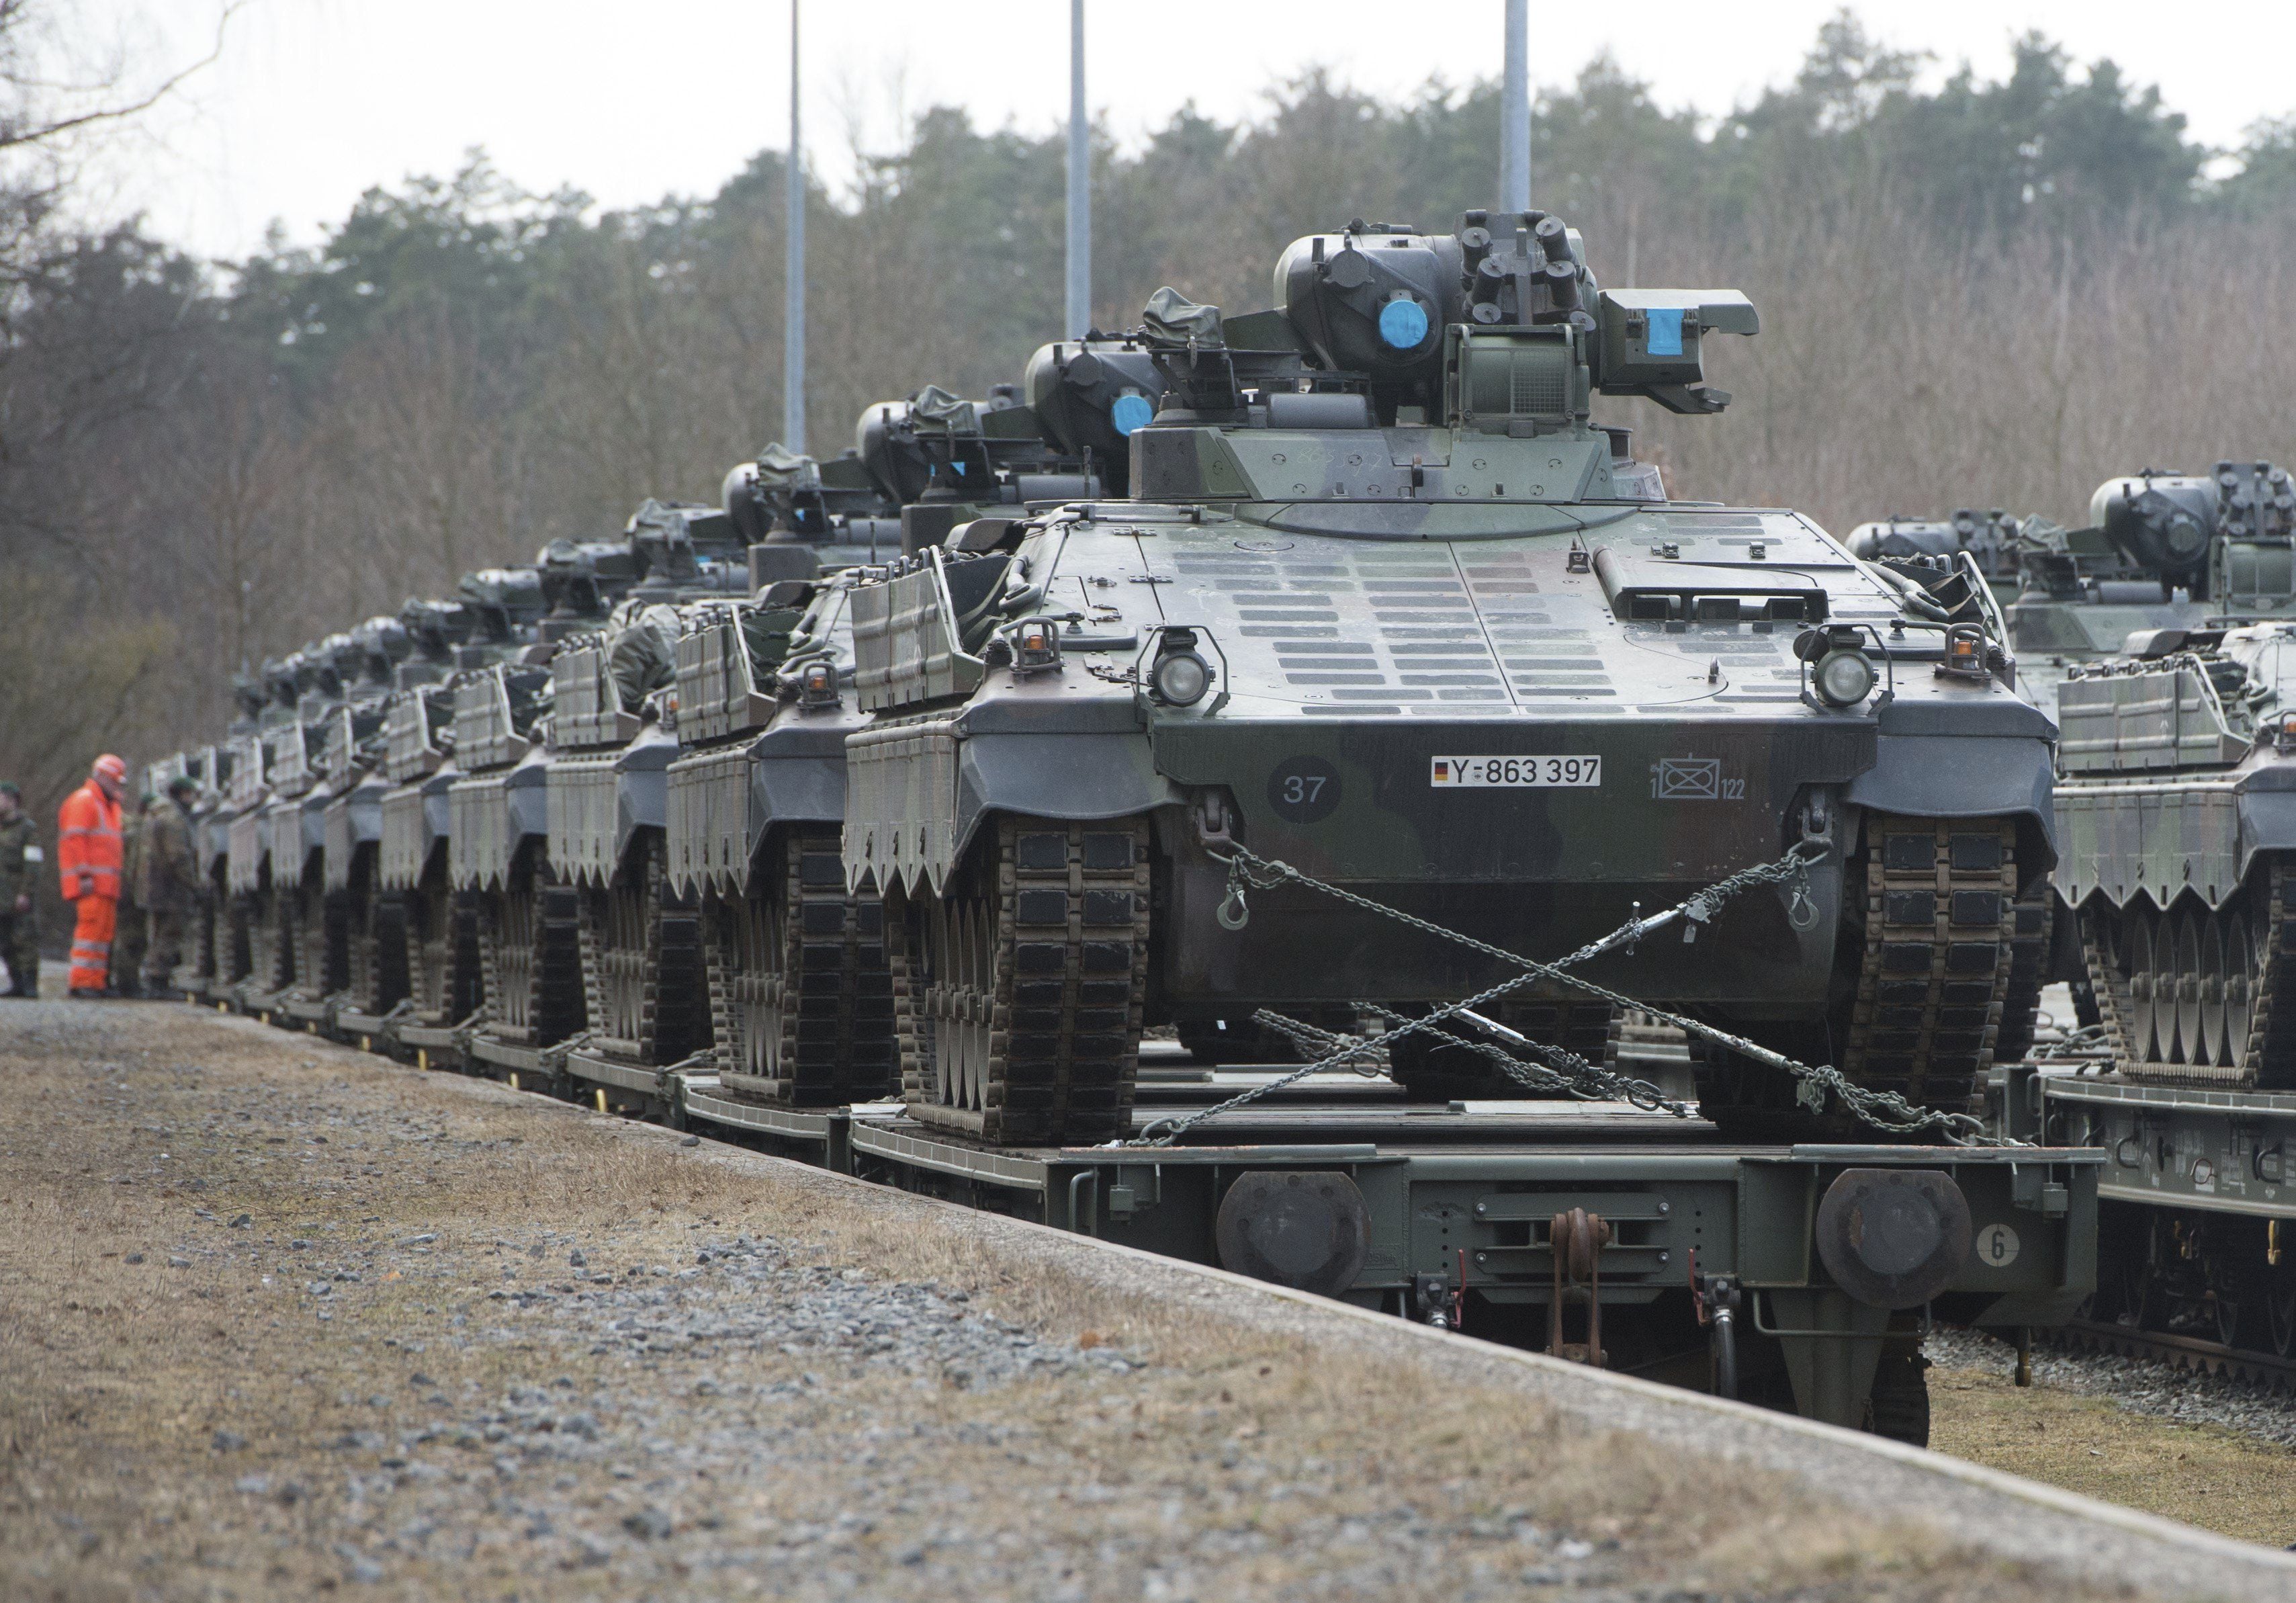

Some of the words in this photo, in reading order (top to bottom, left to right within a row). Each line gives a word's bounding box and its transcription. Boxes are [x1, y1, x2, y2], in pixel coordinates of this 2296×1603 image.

[1452, 759, 1537, 784] Y-863
[1546, 759, 1599, 783] 397
[1283, 775, 1327, 804] 37
[1650, 777, 1657, 799] 1
[1720, 778, 1745, 800] 122
[1991, 1230, 2005, 1260] 6
